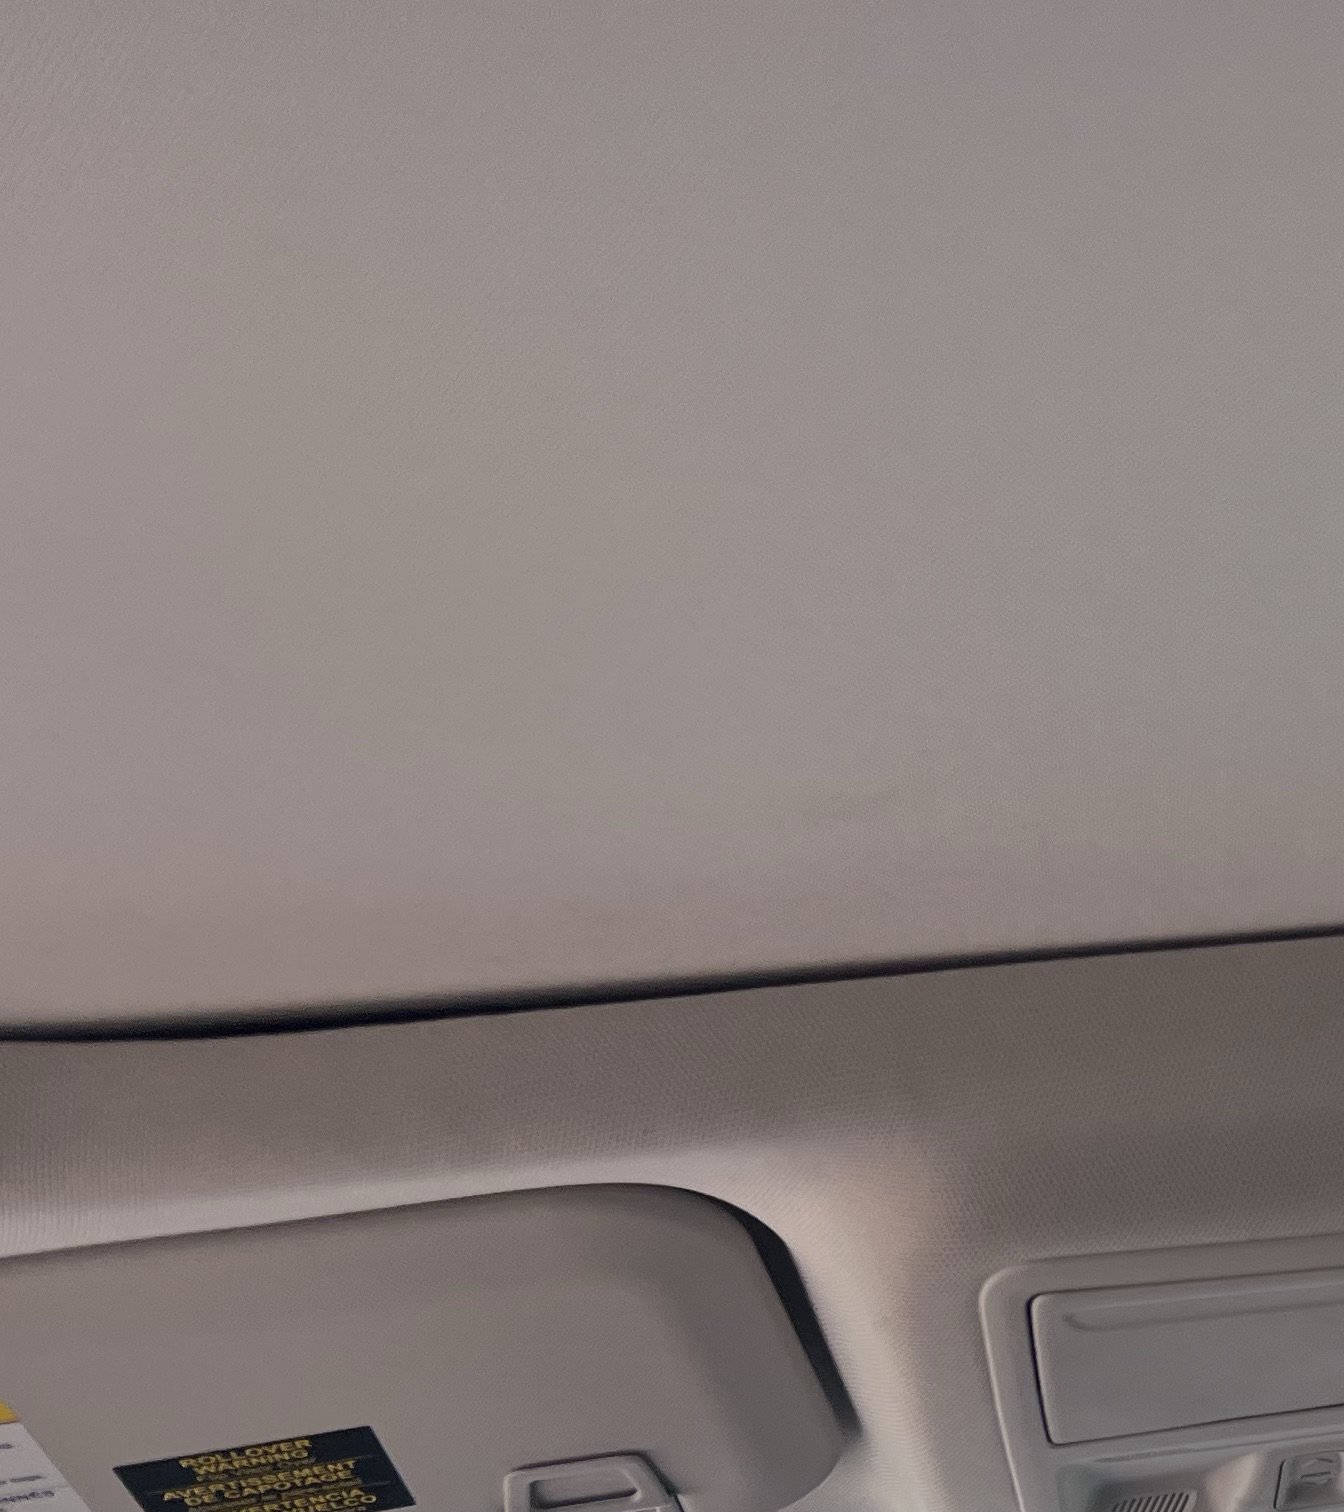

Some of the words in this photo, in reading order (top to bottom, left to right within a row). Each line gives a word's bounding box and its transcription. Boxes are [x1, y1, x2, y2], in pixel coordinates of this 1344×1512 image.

[178, 1438, 313, 1468] ROLLOVER
[193, 1449, 309, 1475] WARNING
[163, 1460, 358, 1501] AVERTISSEMENT
[223, 1470, 353, 1499] CAPOTAGE
